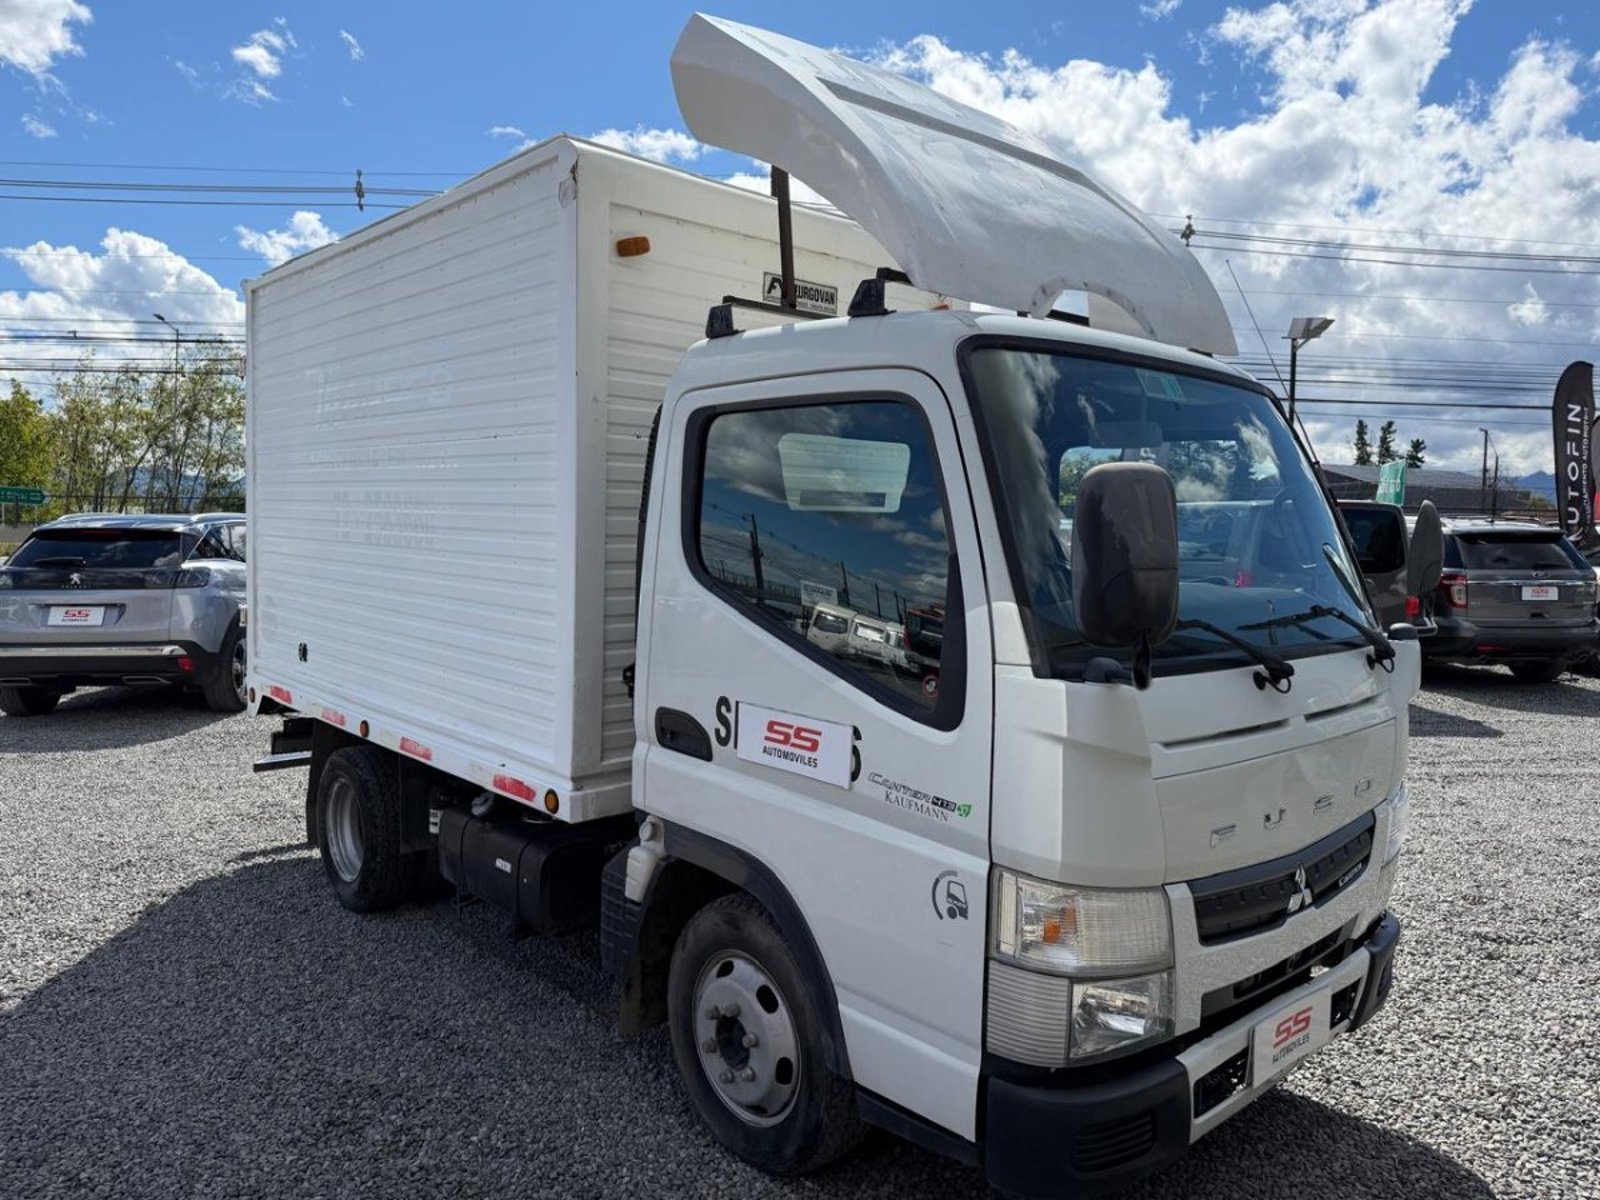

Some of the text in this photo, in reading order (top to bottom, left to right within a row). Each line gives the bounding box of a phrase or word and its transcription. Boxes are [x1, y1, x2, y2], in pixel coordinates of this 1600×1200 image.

[796, 284, 836, 305] URGOVAN
[764, 720, 822, 752] SS
[762, 745, 818, 768] AUTOMOVILES
[884, 790, 948, 821] KAUFMANN
[1211, 778, 1371, 849] FUSO
[1273, 1006, 1313, 1049] SS
